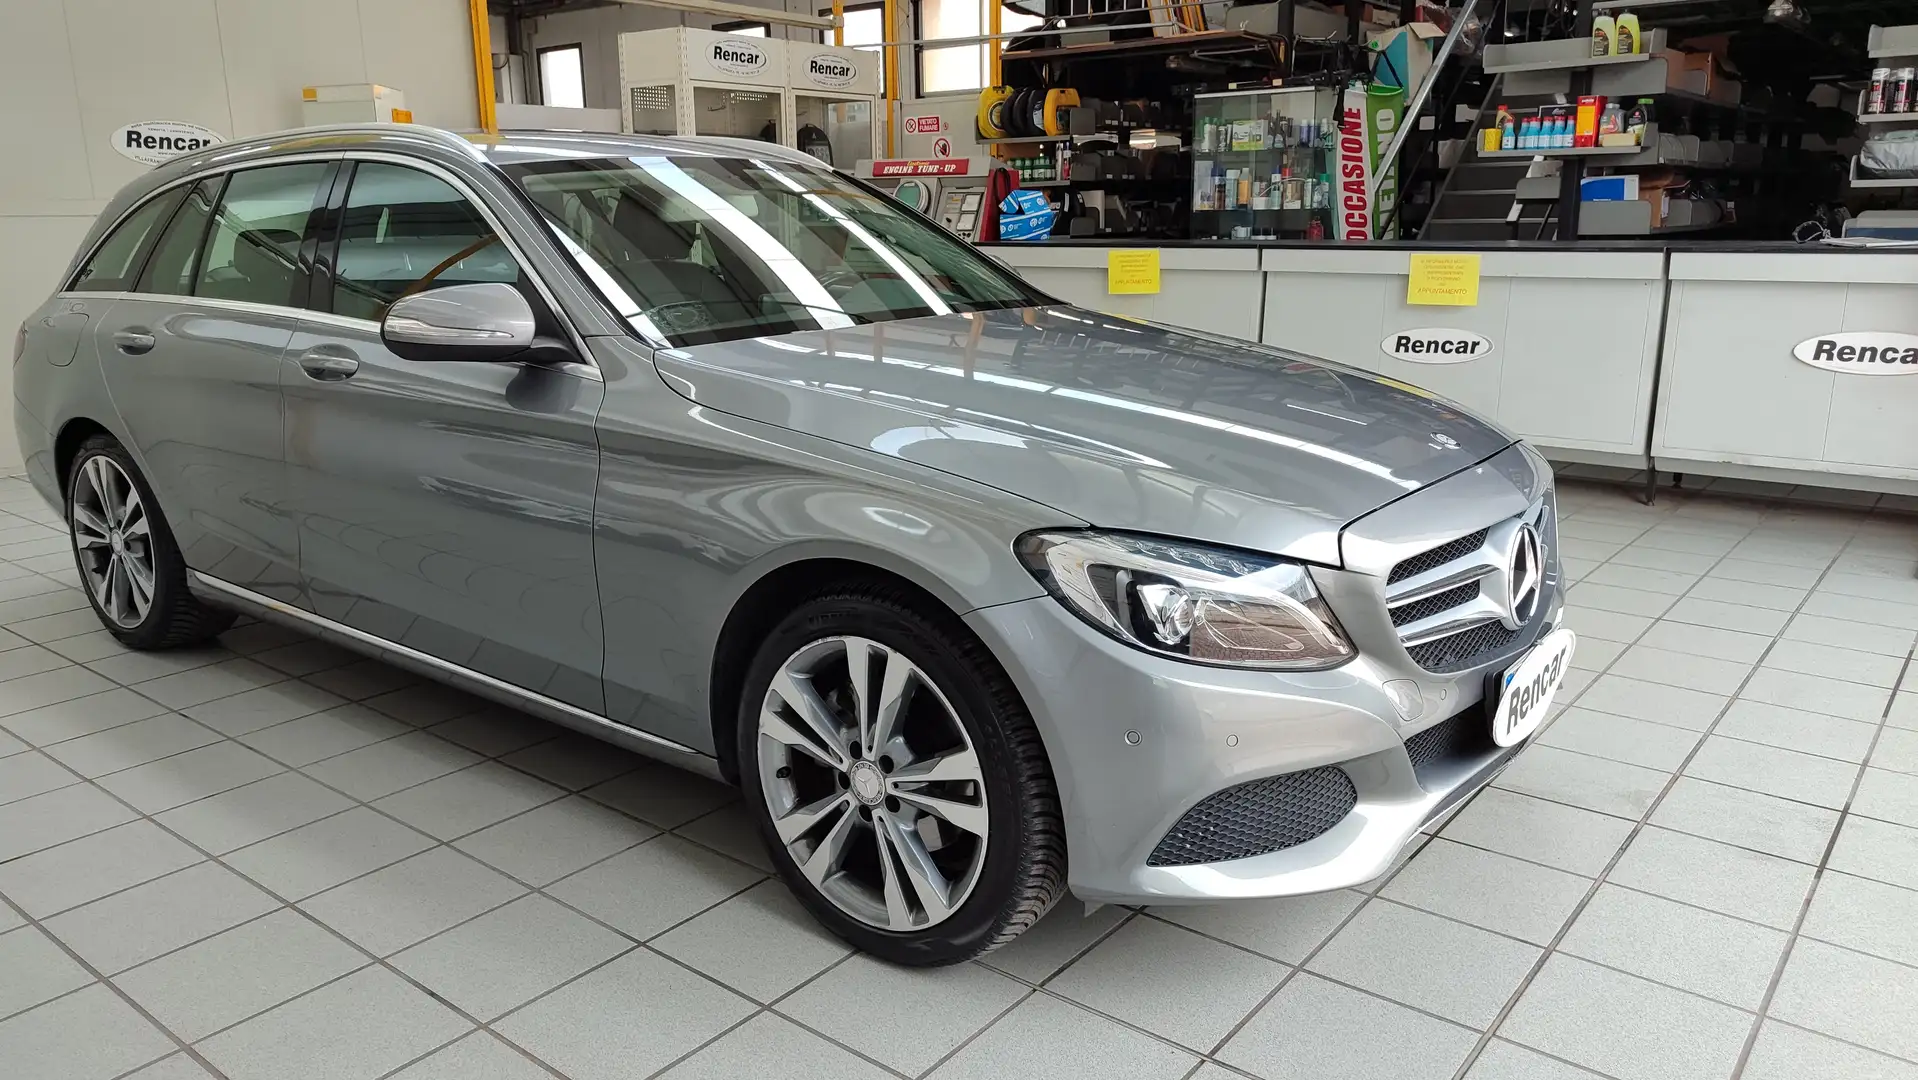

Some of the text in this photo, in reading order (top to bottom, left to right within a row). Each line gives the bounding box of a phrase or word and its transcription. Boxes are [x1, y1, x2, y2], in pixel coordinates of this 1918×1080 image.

[713, 45, 760, 65] Rencar
[810, 59, 851, 77] Rencar
[126, 130, 211, 151] Rencar
[883, 165, 914, 174] ENGINE
[1395, 335, 1481, 354] Rencar
[1506, 644, 1567, 736] Rencar
